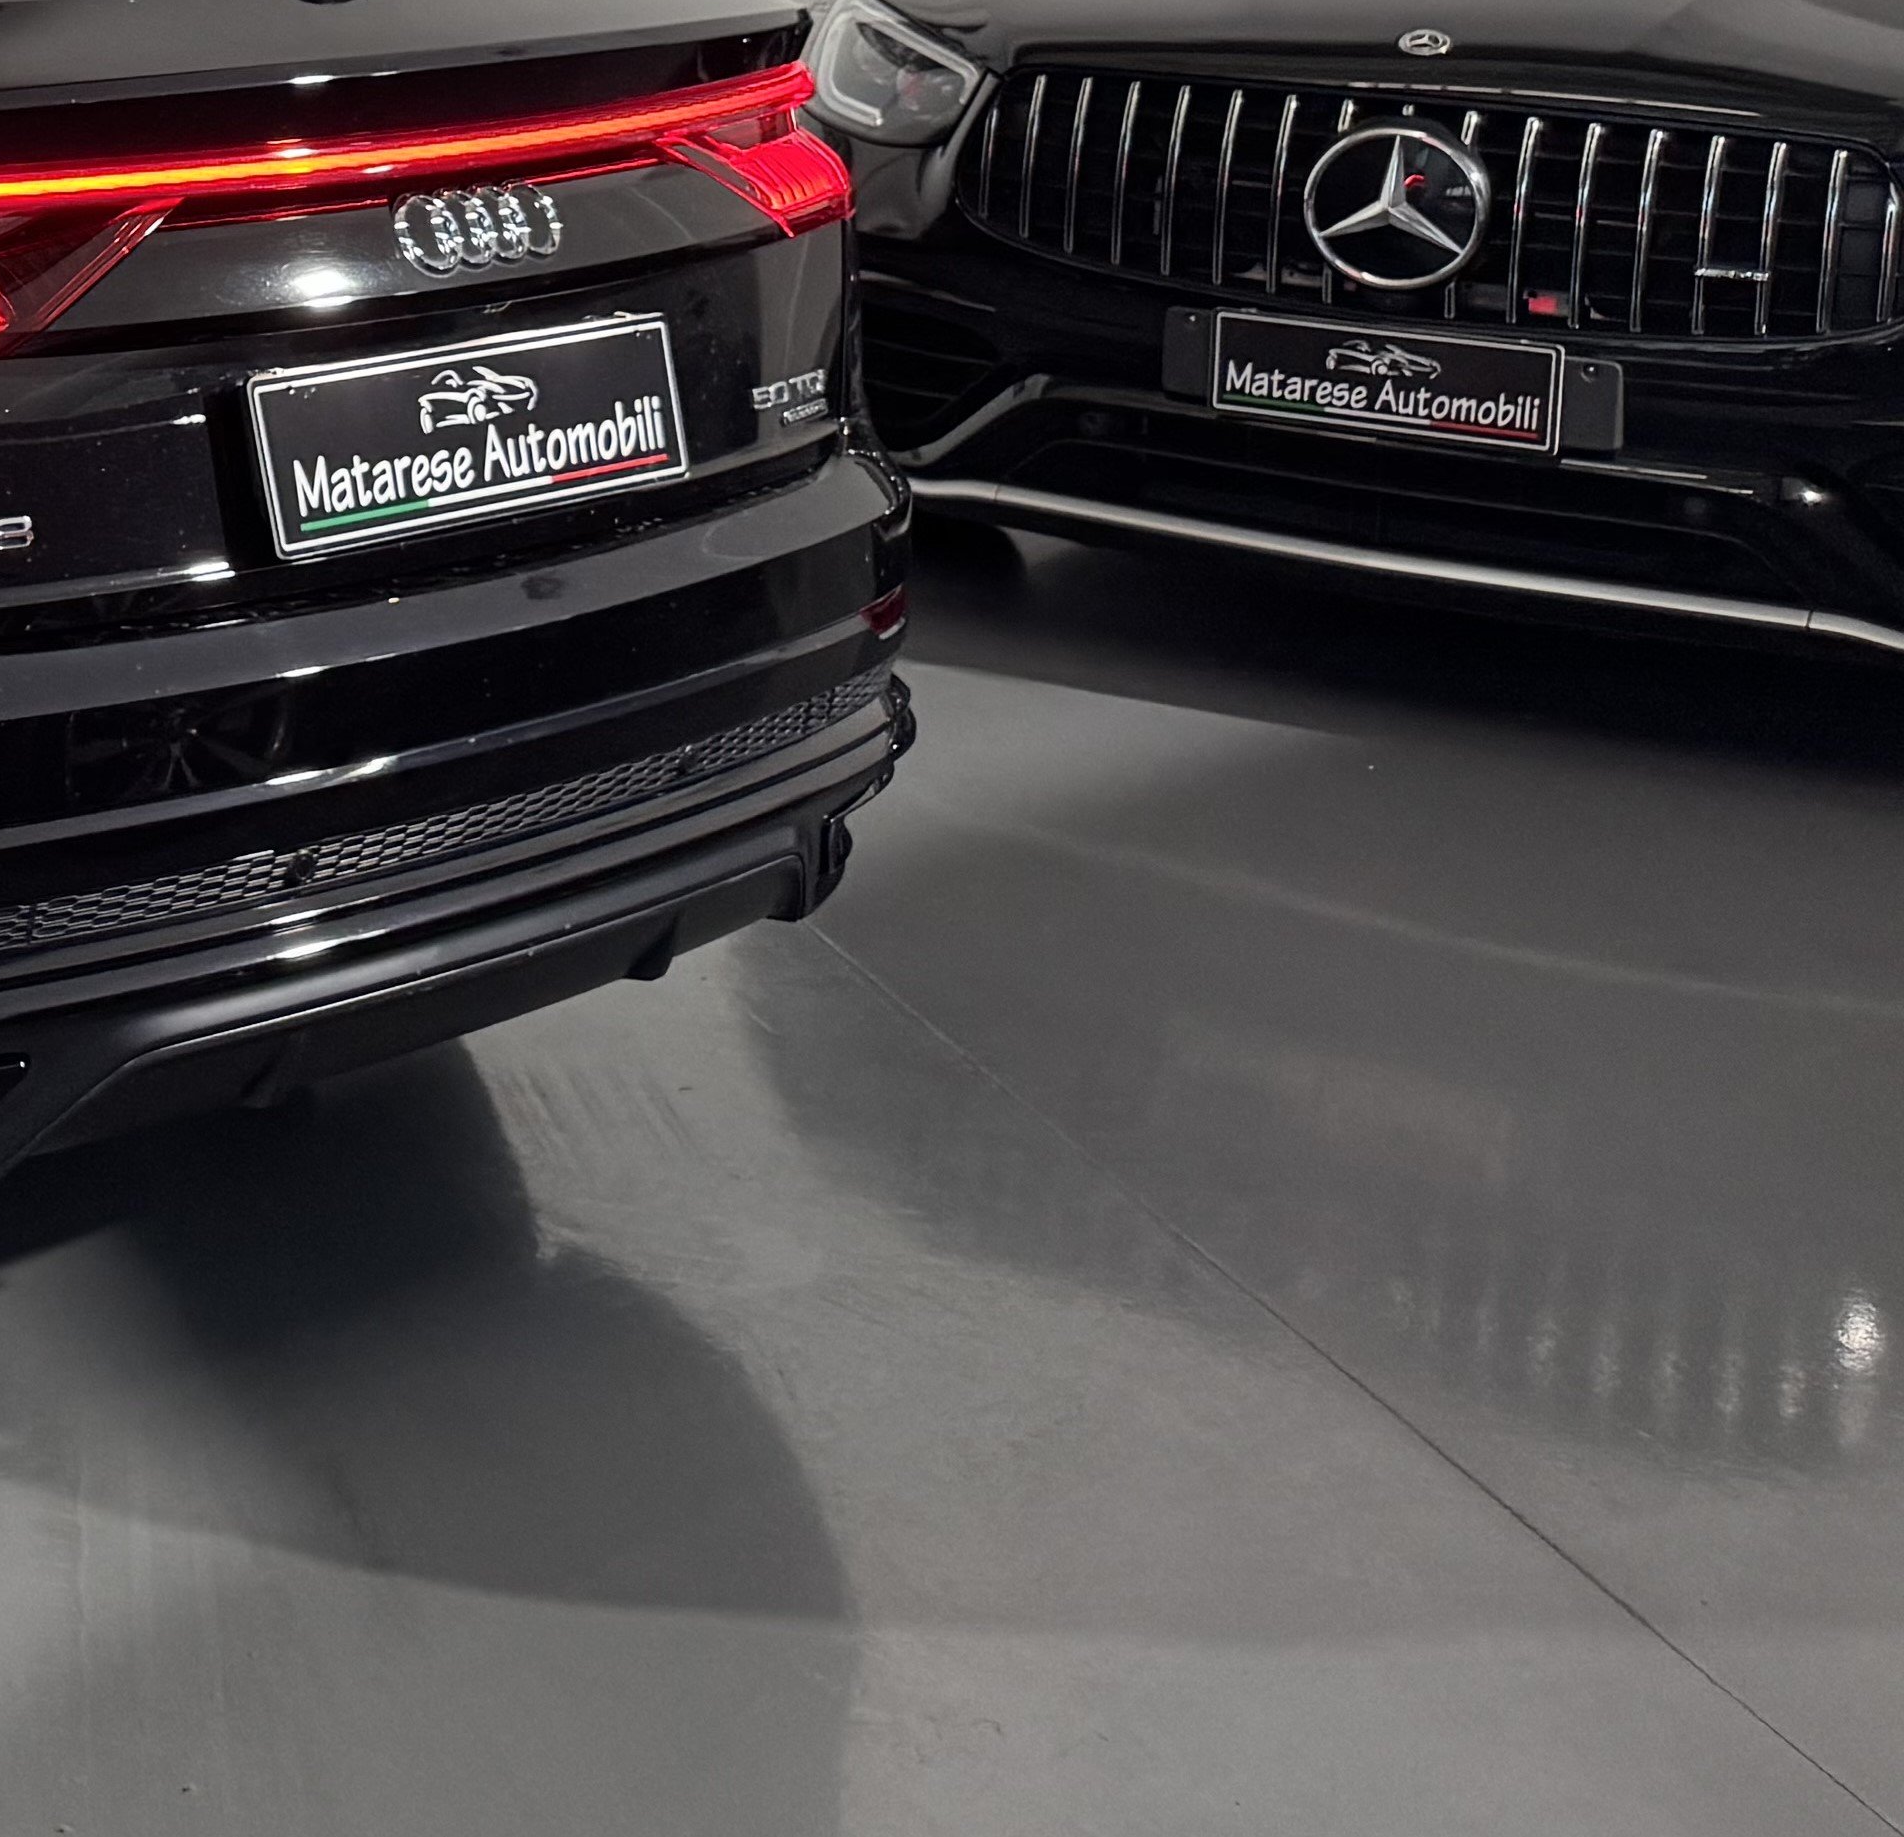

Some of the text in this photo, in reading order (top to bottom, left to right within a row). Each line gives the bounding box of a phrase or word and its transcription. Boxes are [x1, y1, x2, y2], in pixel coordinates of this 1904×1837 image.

[751, 381, 789, 410] 50
[1224, 359, 1540, 431] Matarese Automobili
[293, 395, 666, 519] Matarese Automobili
